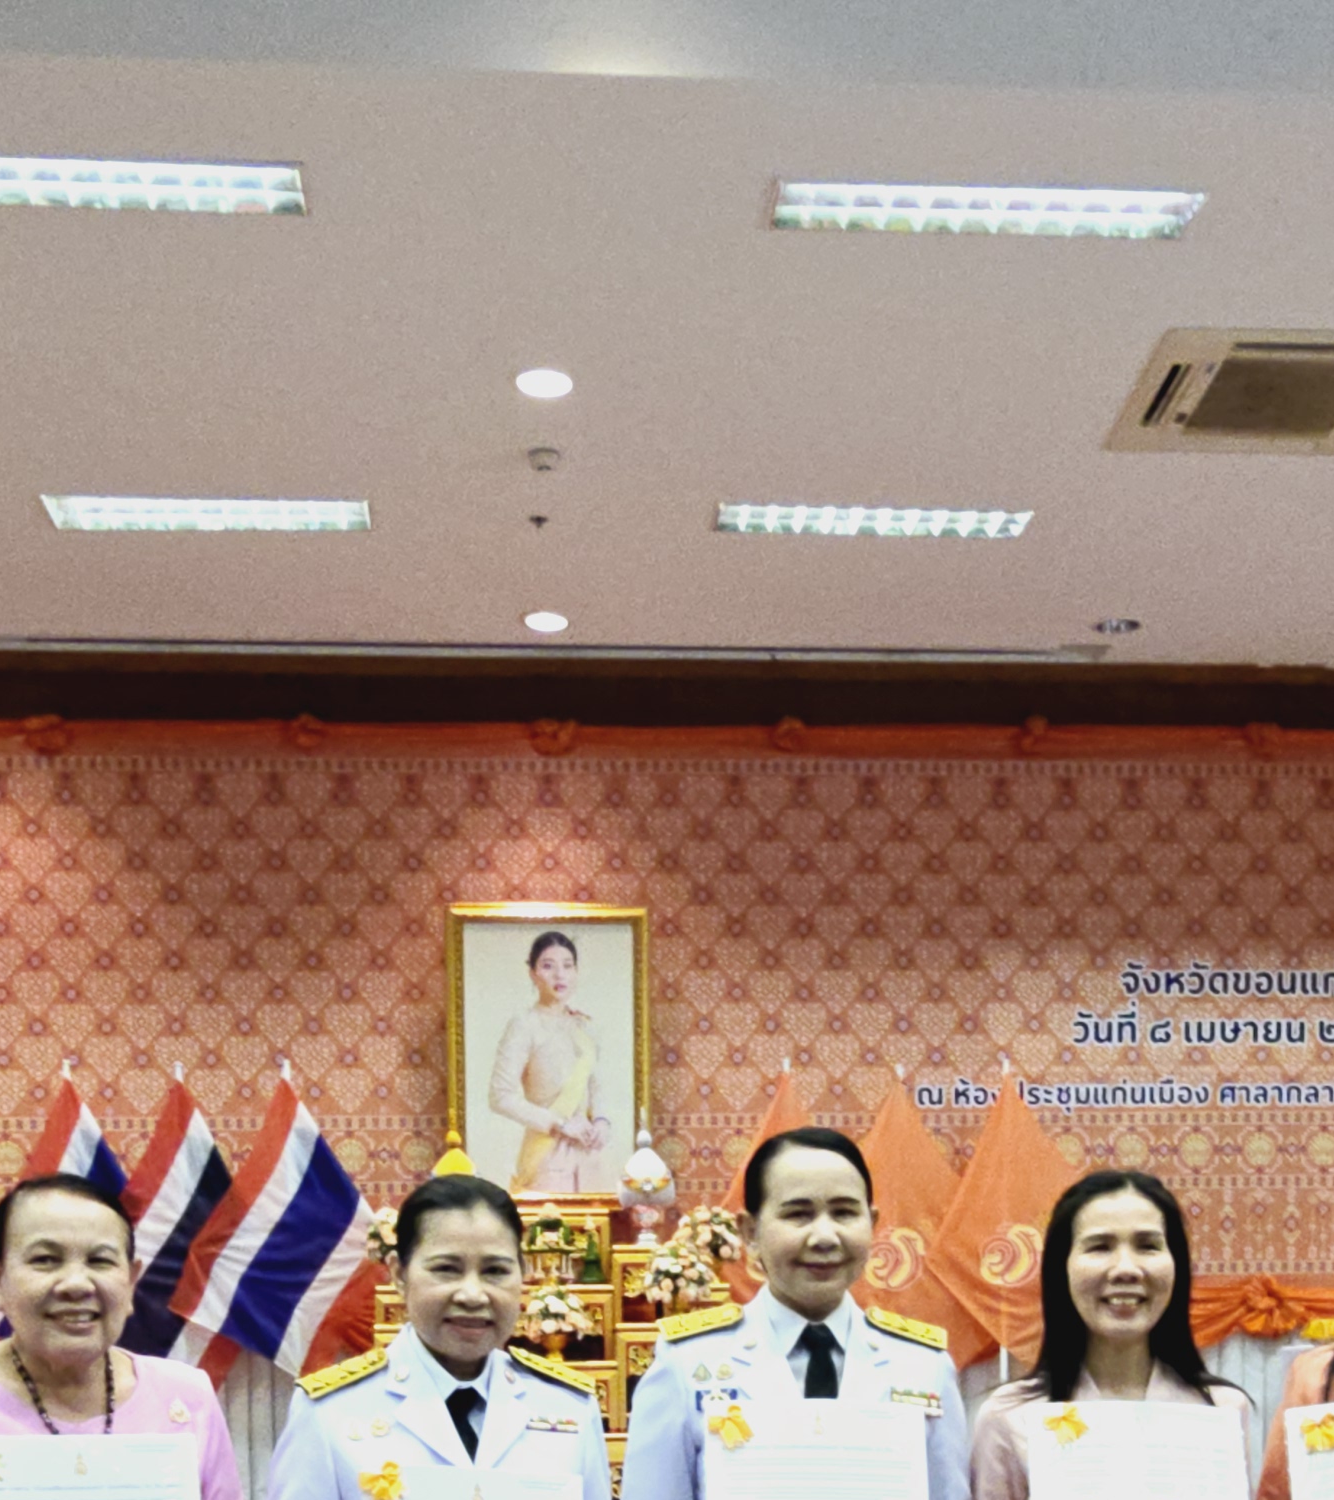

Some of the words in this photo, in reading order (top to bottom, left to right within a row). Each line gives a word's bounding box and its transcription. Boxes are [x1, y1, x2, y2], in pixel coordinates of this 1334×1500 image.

[1072, 1000, 1137, 1043] วันที่
[1149, 1019, 1172, 1043] ๘
[1183, 1019, 1305, 1043] เมษายน
[917, 1086, 943, 1106] ณ
